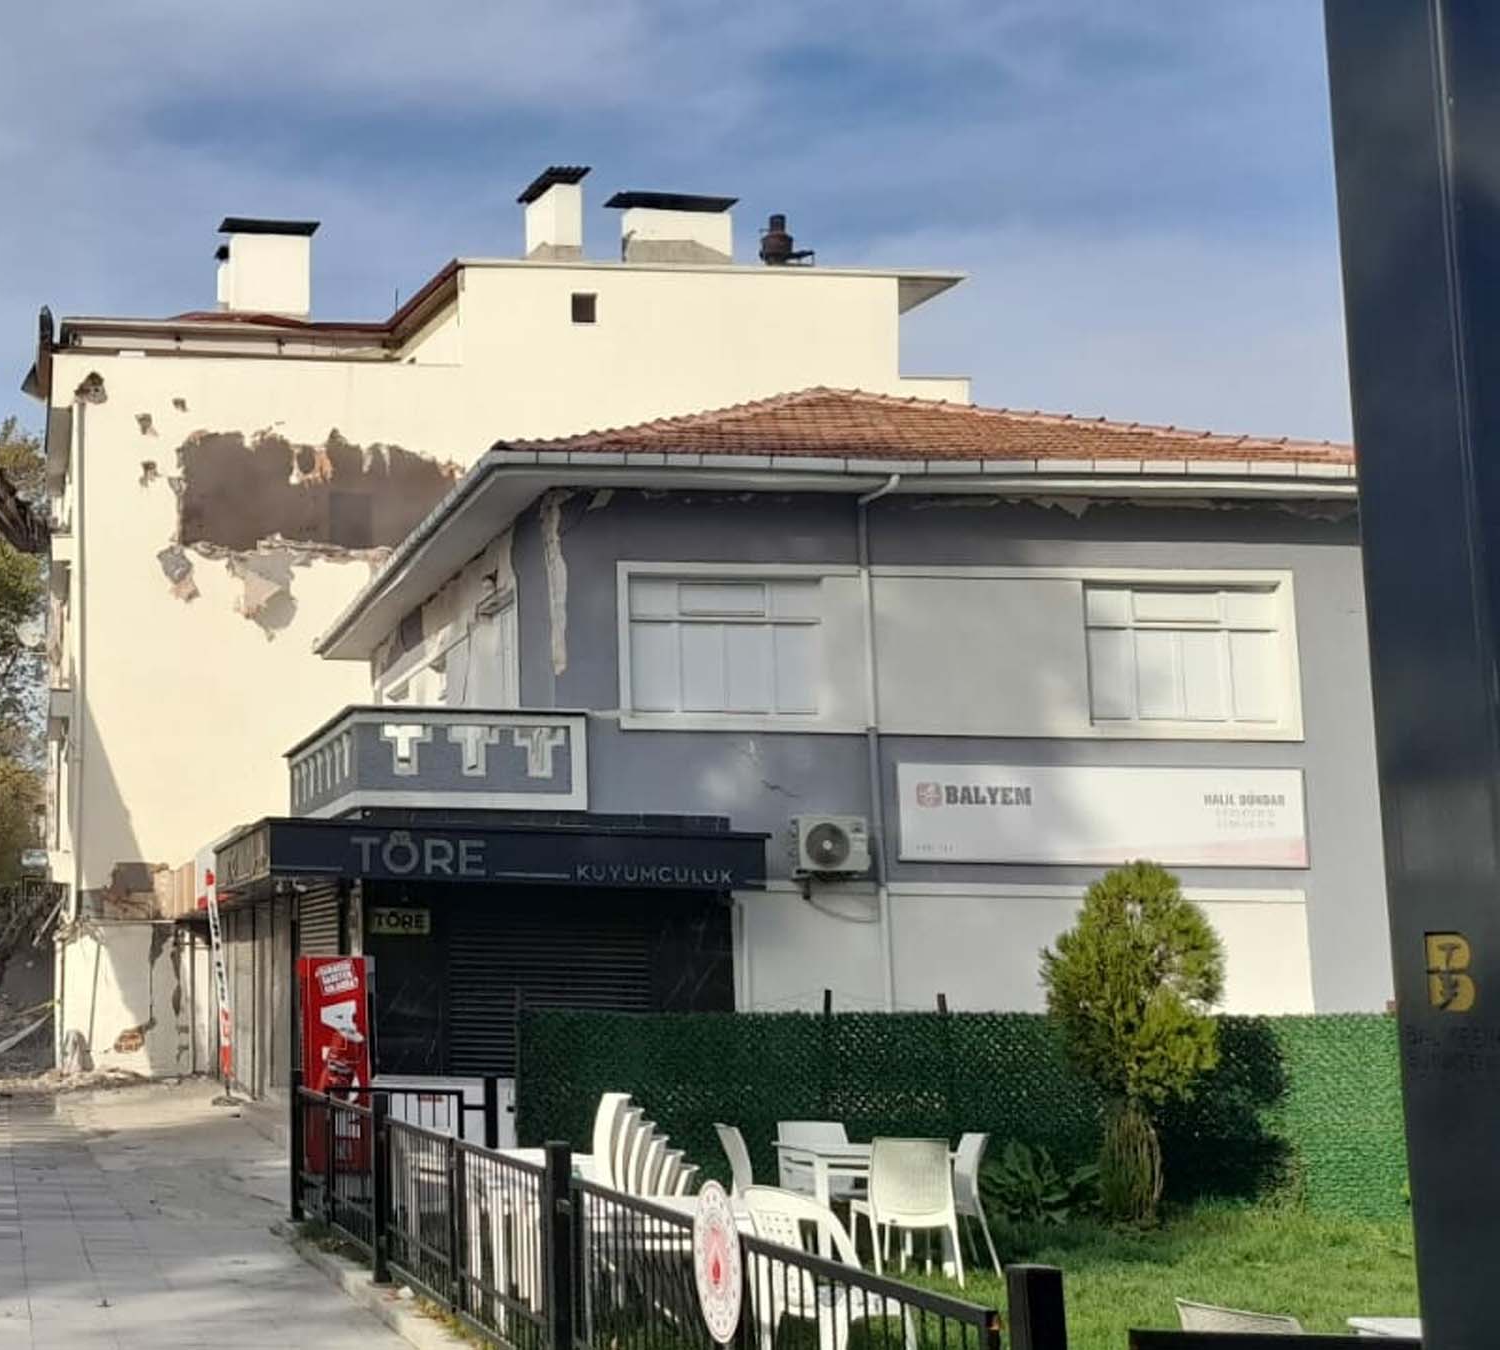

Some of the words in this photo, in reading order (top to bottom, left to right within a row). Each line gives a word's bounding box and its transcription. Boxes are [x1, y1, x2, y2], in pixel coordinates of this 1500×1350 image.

[944, 785, 1032, 806] BALYEM
[350, 830, 487, 876] TÖRE
[576, 863, 733, 884] KUYUMCULUK
[373, 911, 426, 930] TÖRE
